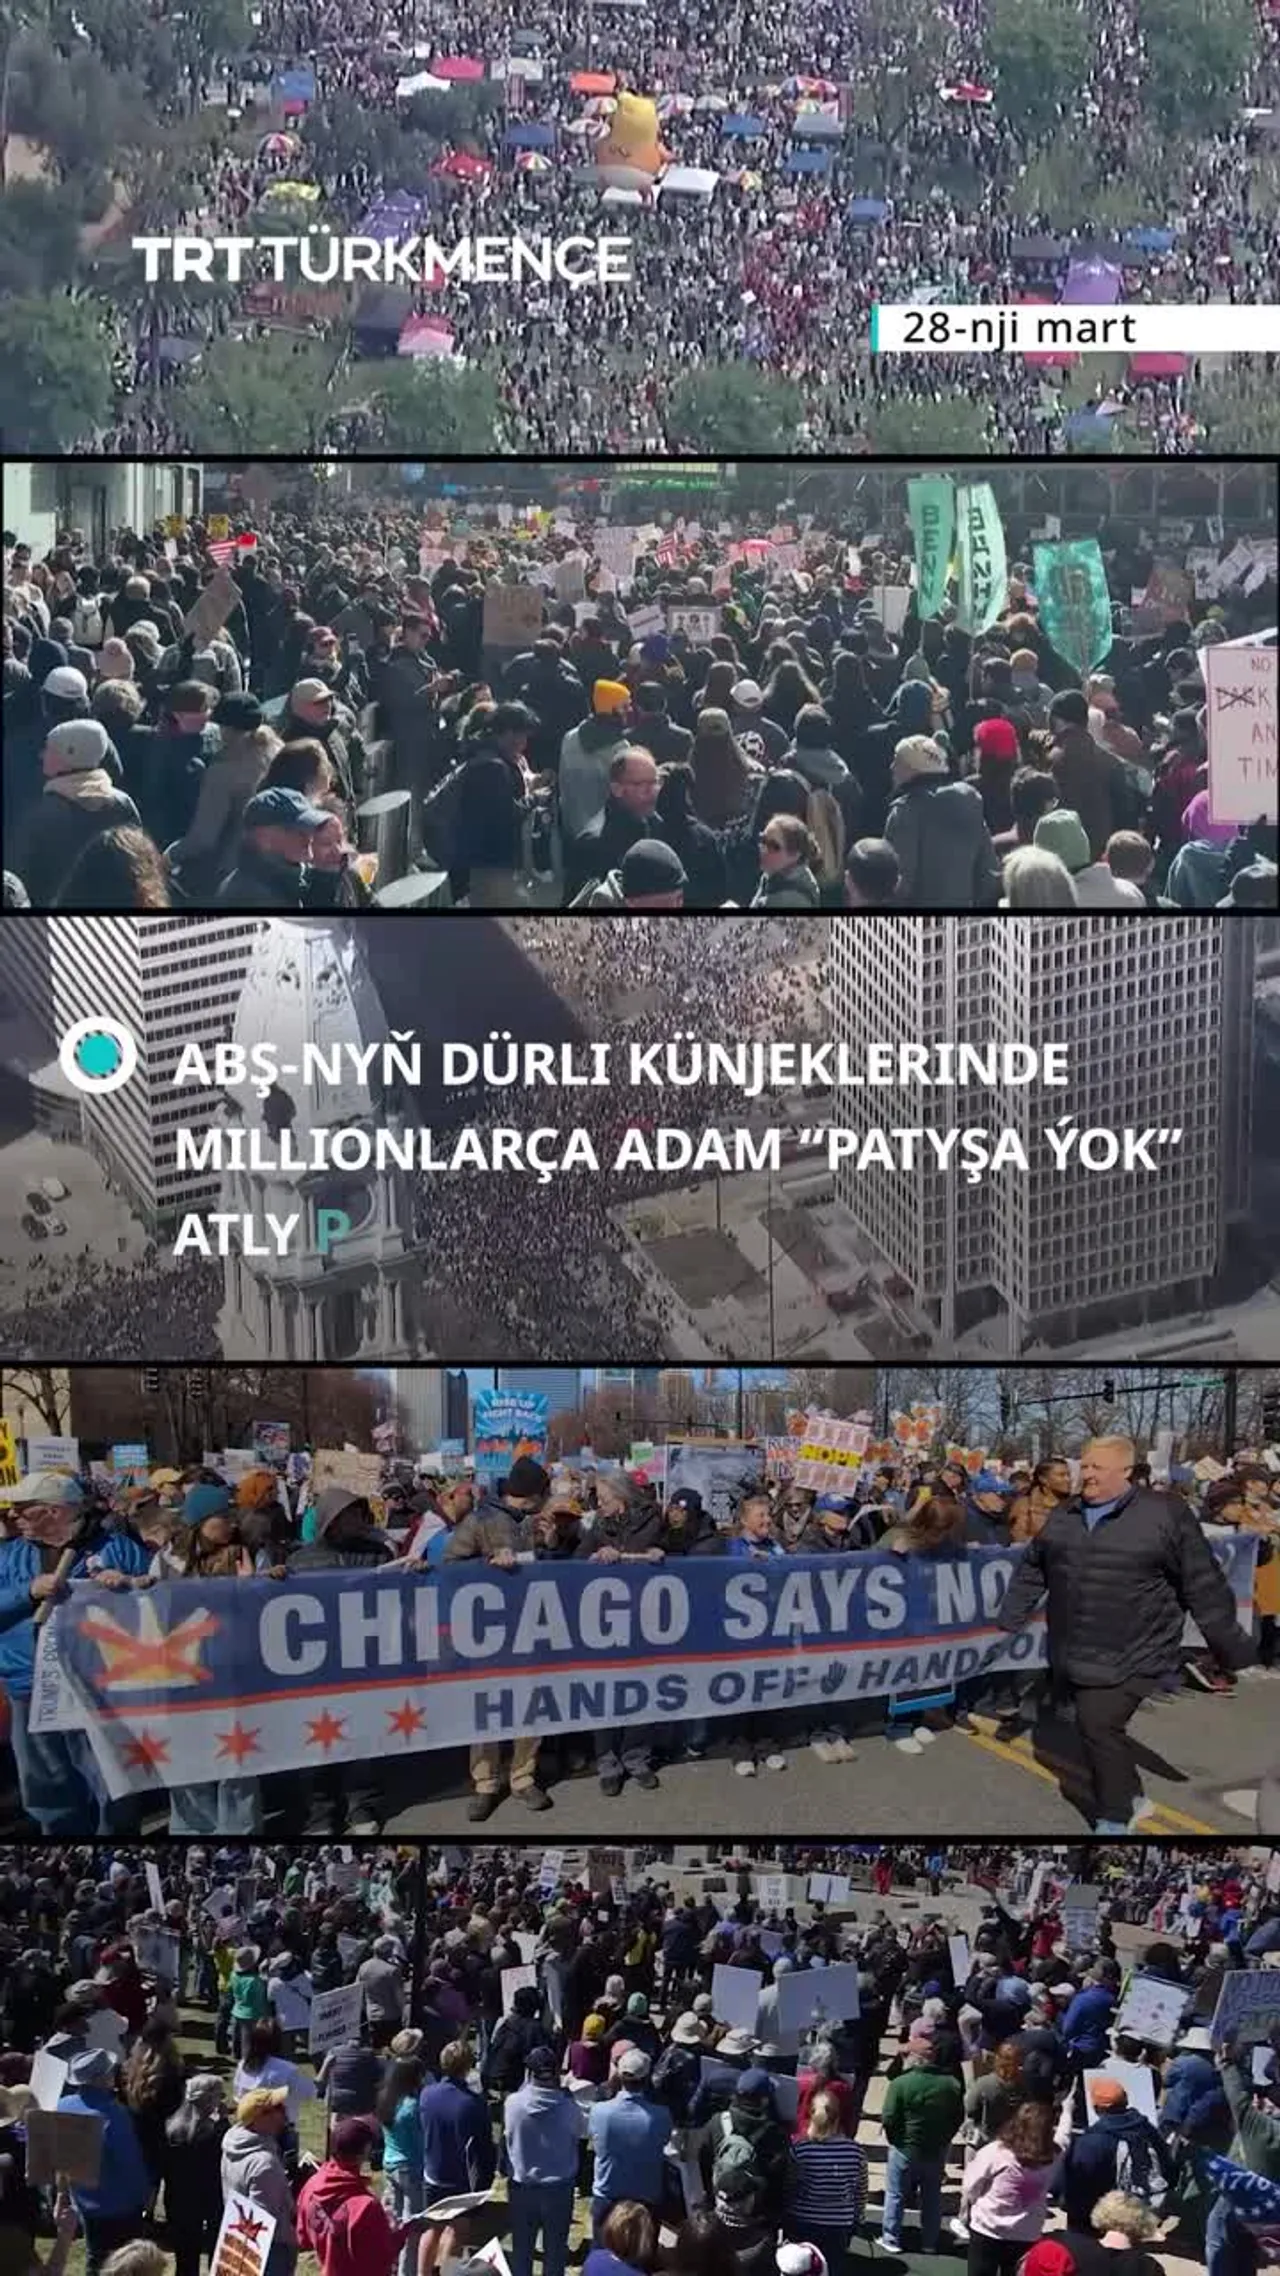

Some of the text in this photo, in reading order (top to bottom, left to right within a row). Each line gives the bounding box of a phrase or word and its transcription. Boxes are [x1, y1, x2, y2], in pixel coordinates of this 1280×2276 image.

[1251, 656, 1272, 672] NO
[259, 1559, 1014, 1675] CHICAGO SAYS NO
[474, 1675, 689, 1731] HANDS
[708, 1665, 811, 1705] OFF
